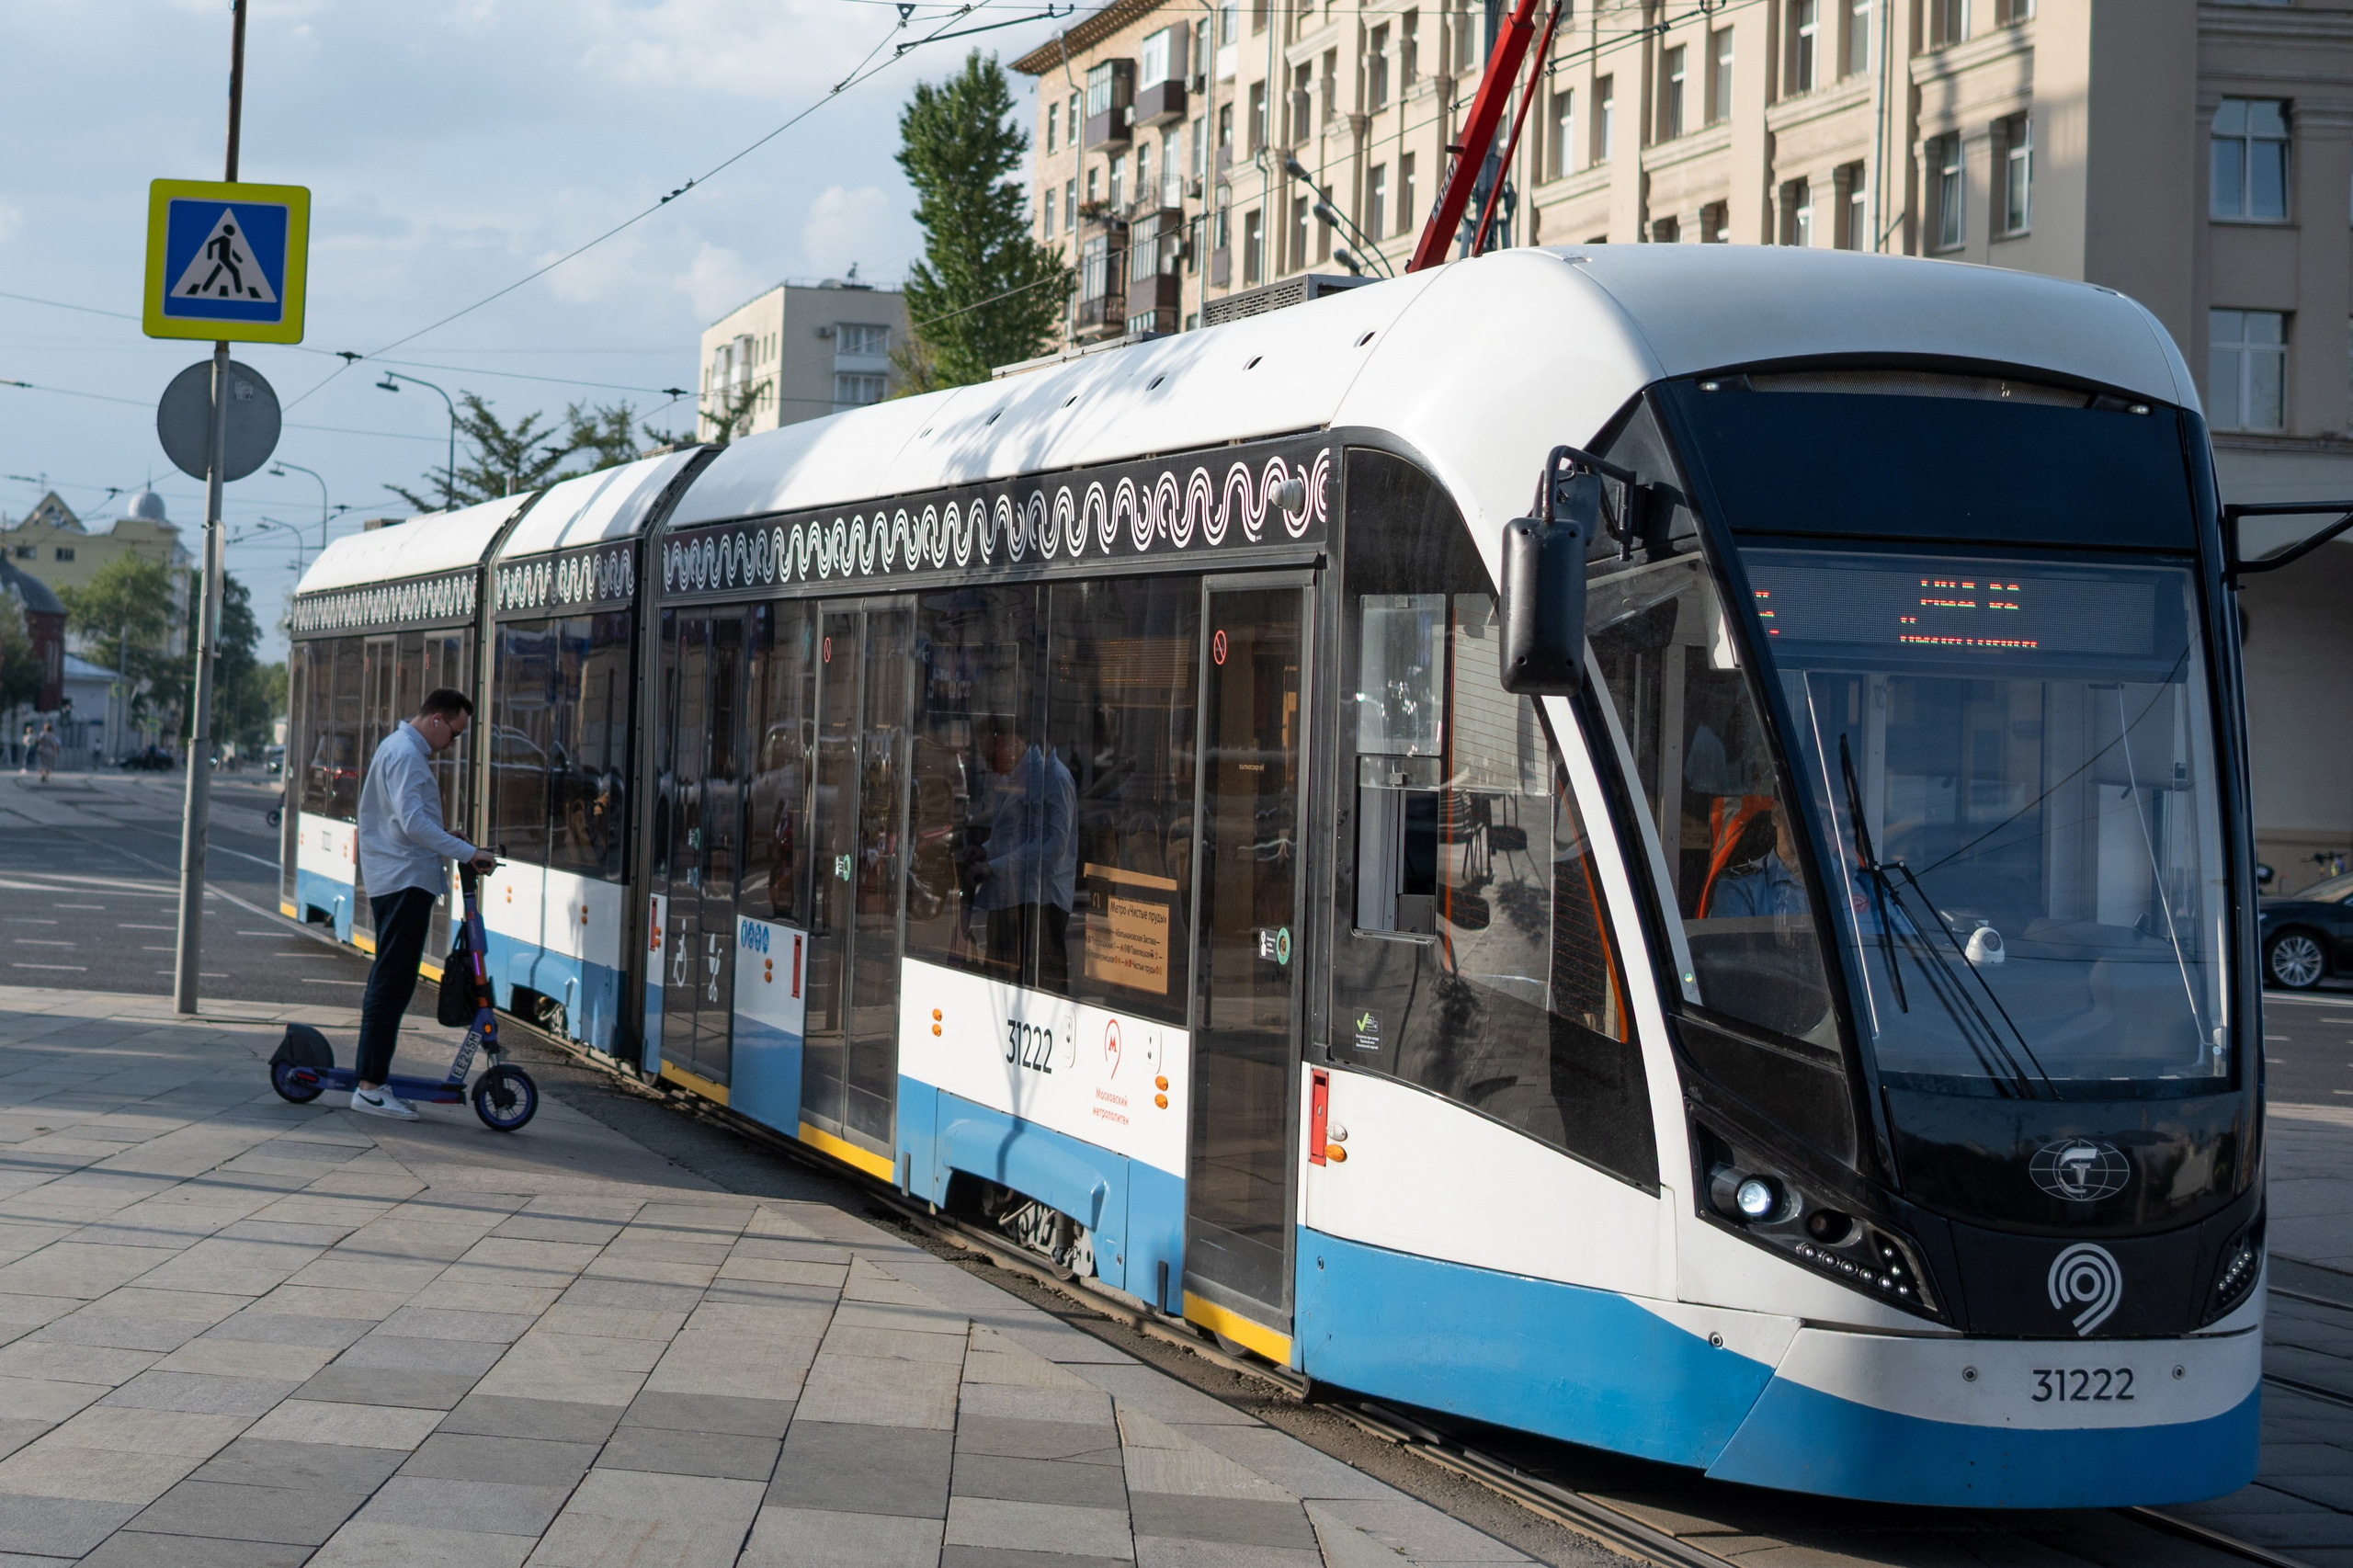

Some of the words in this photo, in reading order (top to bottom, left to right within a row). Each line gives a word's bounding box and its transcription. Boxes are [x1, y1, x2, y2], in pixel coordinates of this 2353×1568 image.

[1109, 901, 1127, 916] Метро
[1127, 903, 1148, 921] «Чистые
[1148, 911, 1167, 926] пруды»
[1006, 1018, 1053, 1074] 31222
[1095, 1086, 1129, 1108] Московский
[1092, 1106, 1131, 1126] метрополитен
[2030, 1367, 2135, 1403] 31222
